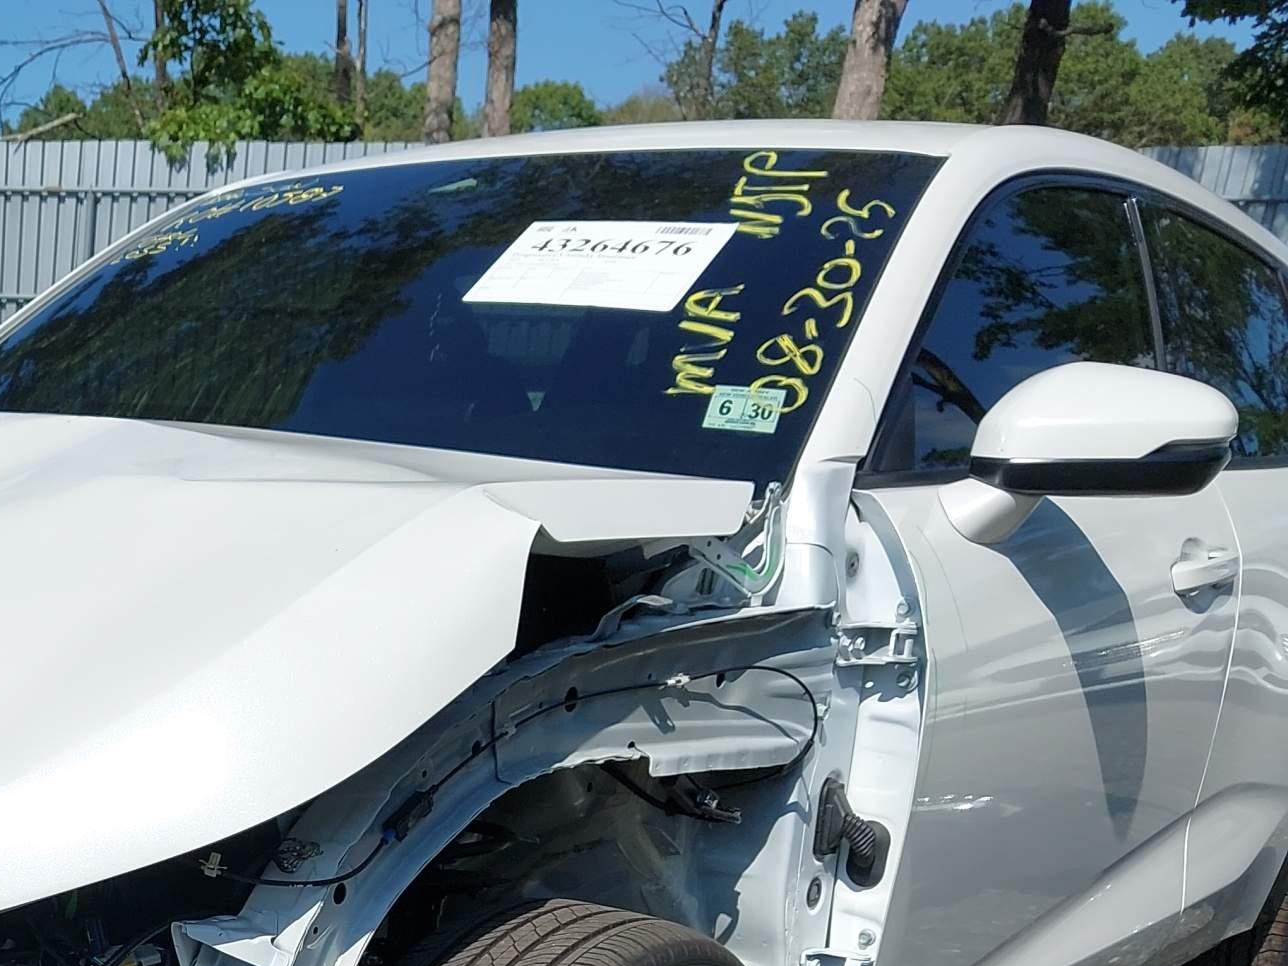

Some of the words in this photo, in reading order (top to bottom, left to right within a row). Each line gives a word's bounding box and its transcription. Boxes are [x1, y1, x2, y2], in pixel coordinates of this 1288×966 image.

[530, 238, 696, 257] 43264676
[749, 188, 896, 413] 08-30-25
[719, 400, 733, 416] 6
[748, 403, 774, 420] 30
